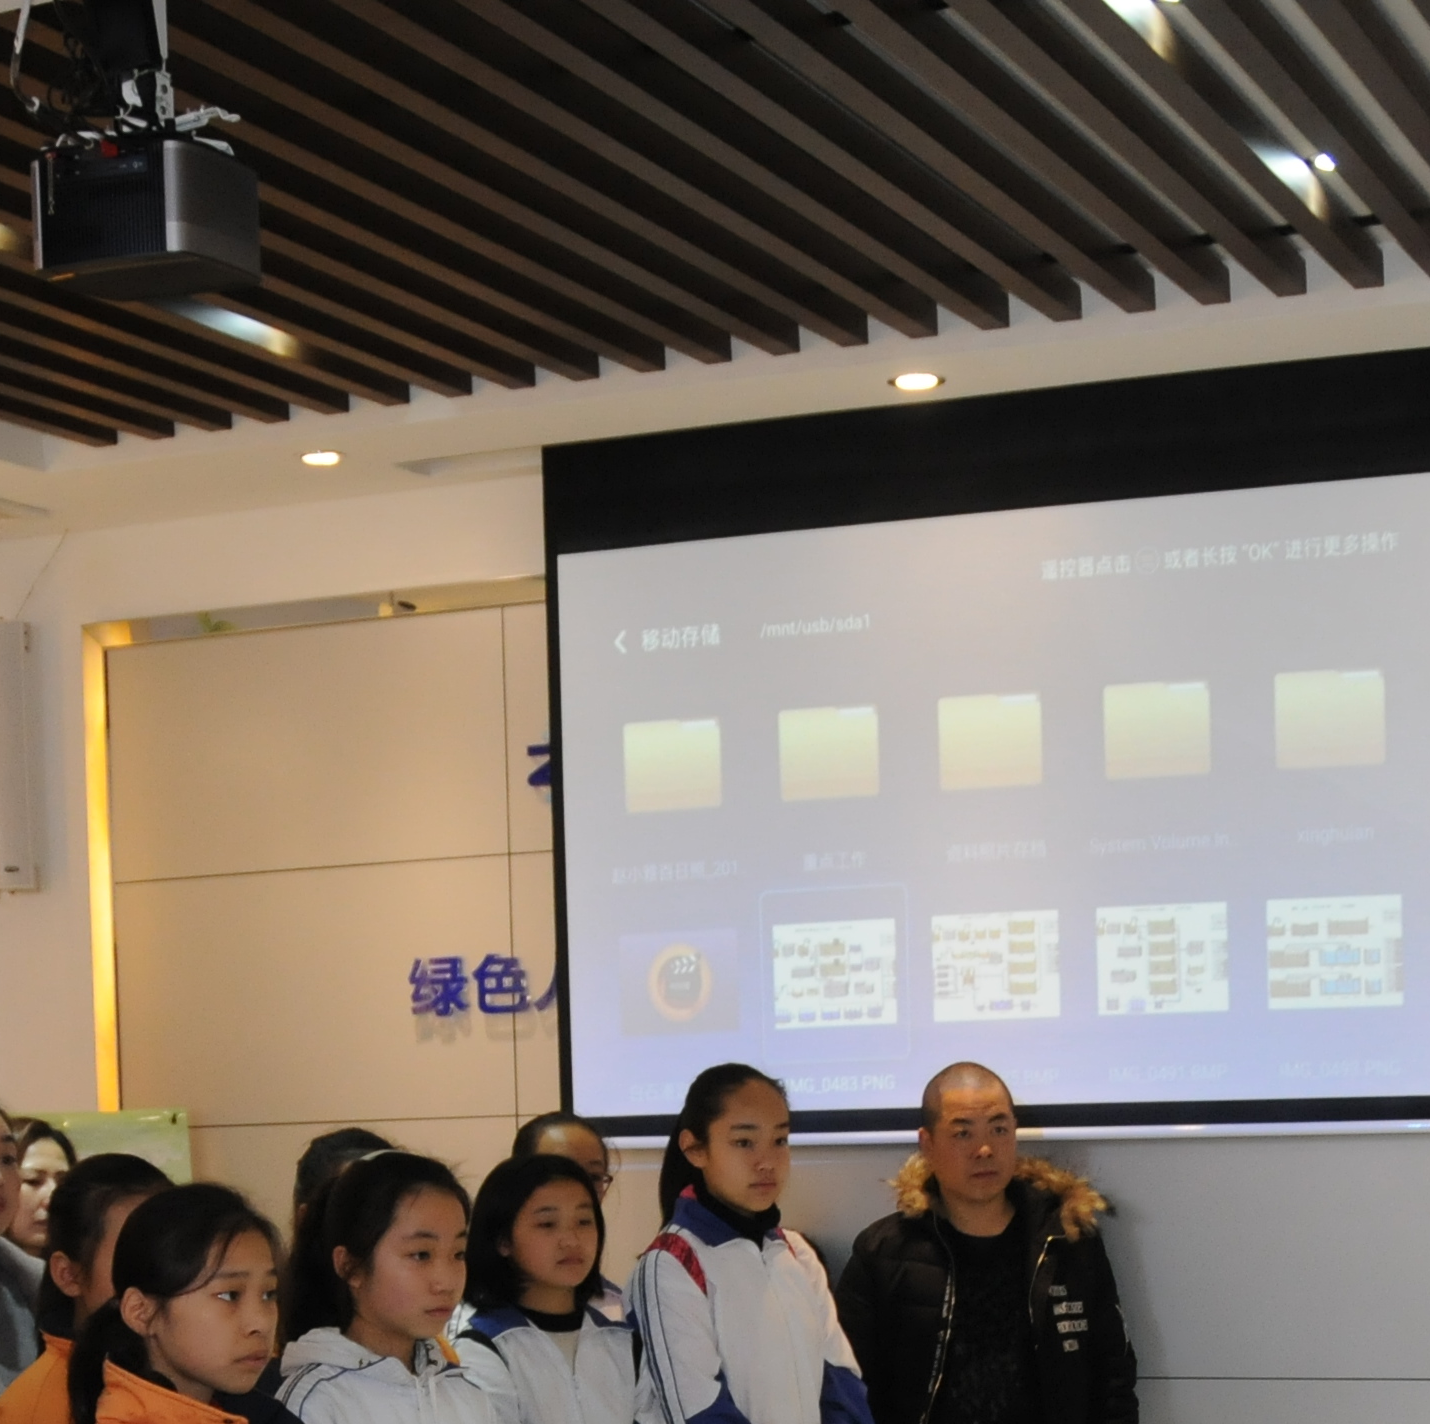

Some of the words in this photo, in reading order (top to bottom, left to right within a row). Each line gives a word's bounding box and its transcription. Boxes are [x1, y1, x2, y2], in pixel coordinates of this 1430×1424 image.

[1041, 553, 1132, 582] 遥控器点击
[1163, 543, 1239, 571] 或者长按
[1285, 530, 1401, 561] 进行更多操作
[640, 622, 721, 652] 移动存储
[759, 612, 871, 640] /mnt/usb/sda1
[408, 953, 557, 1016] 绿色
